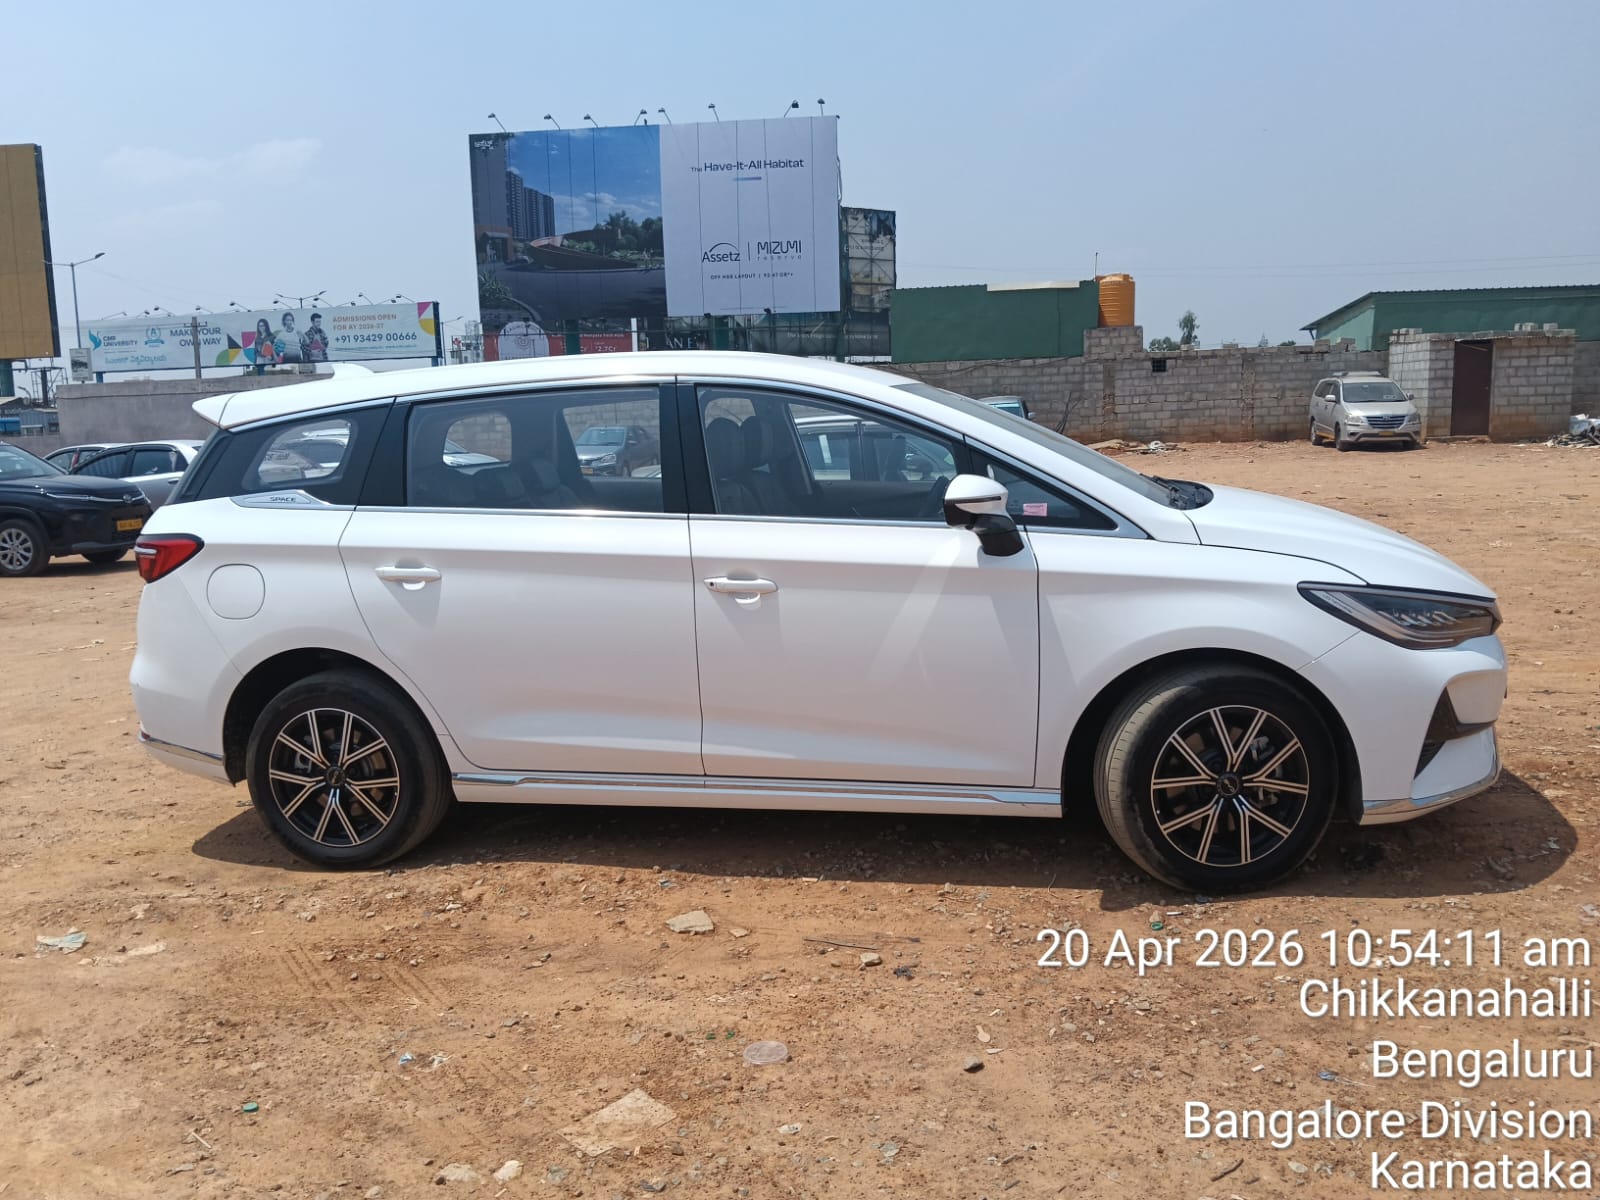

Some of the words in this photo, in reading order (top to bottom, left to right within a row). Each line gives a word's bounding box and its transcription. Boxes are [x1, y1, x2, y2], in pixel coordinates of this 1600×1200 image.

[704, 160, 762, 172] Have-It-All
[763, 159, 805, 169] Habitat
[757, 240, 802, 255] MIZUMI
[702, 251, 741, 263] Assetz
[202, 337, 222, 345] WAY
[335, 334, 351, 343] +91
[353, 333, 383, 343] 93429
[385, 332, 417, 341] 00666
